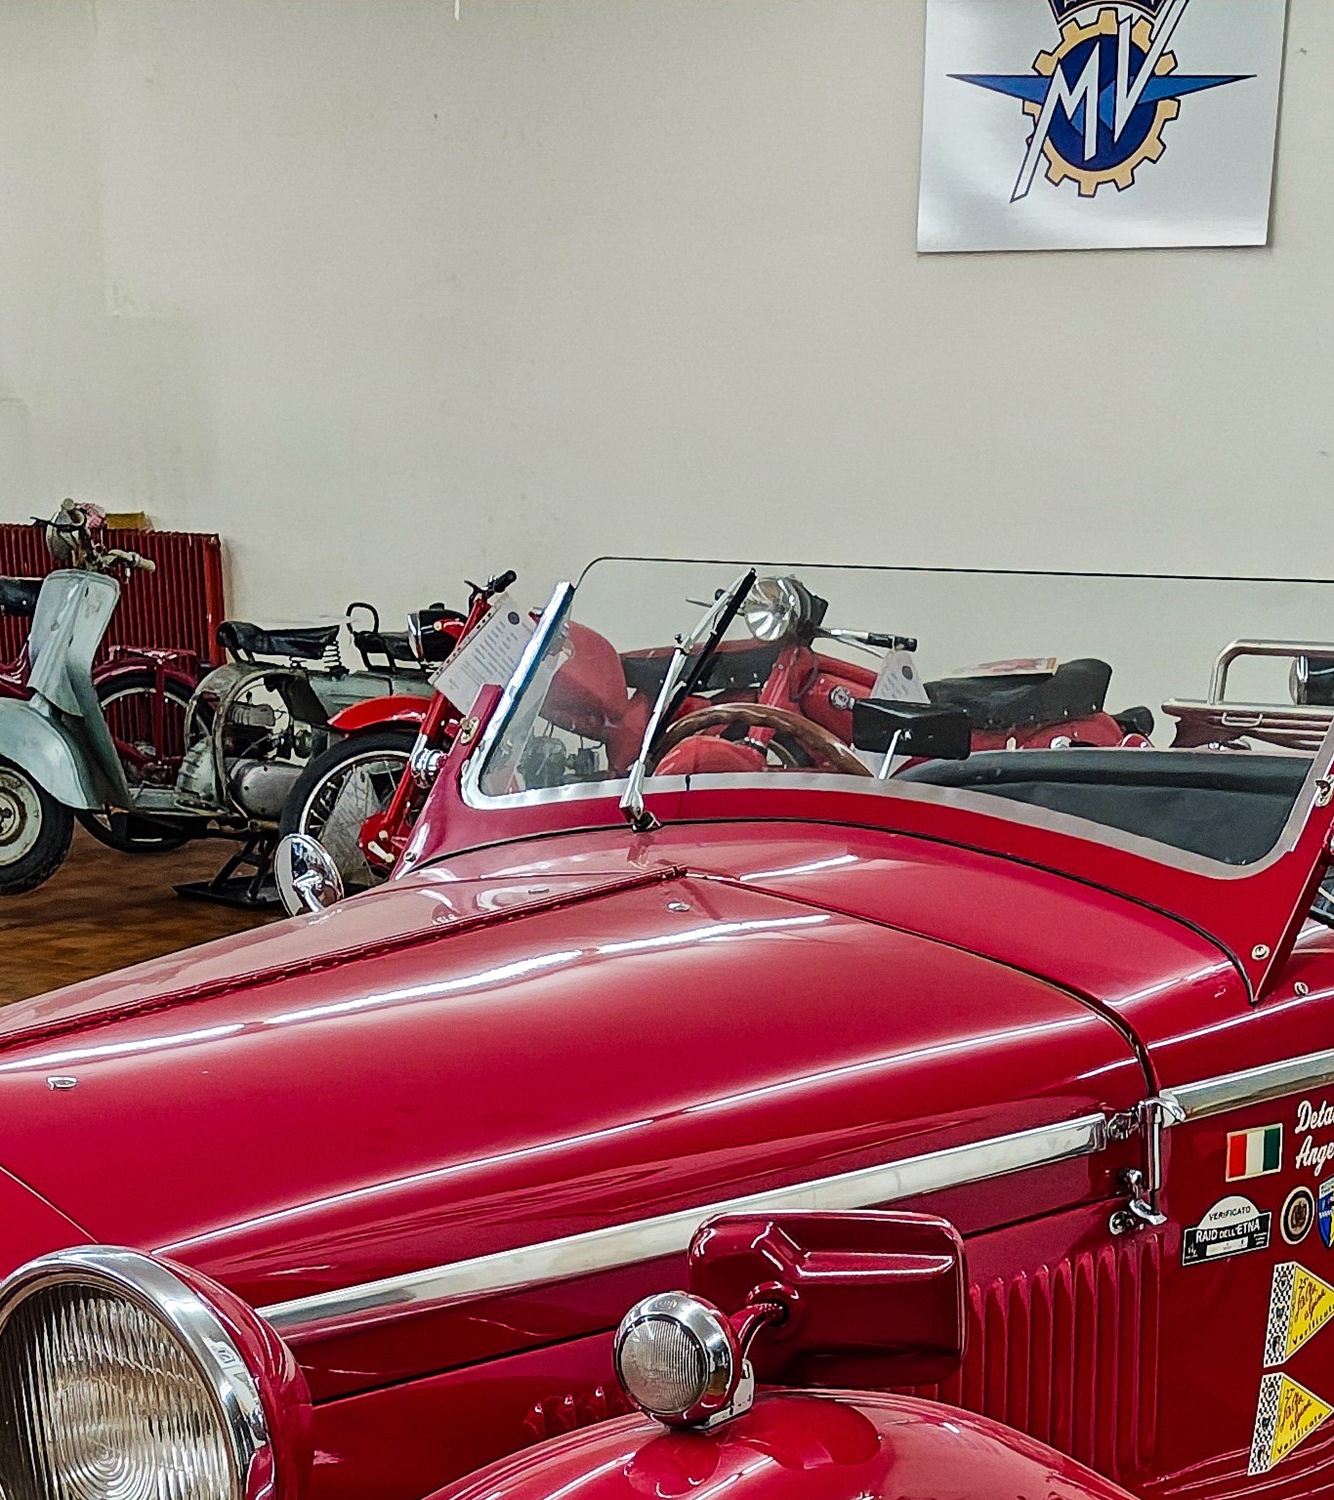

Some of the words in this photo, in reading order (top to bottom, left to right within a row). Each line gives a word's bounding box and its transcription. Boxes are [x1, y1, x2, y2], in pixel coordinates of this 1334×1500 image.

[1010, 0, 1189, 203] MV
[1209, 1206, 1251, 1221] VERIFICATO
[1196, 1230, 1218, 1244] RAID
[1277, 1412, 1323, 1455] Verificato
